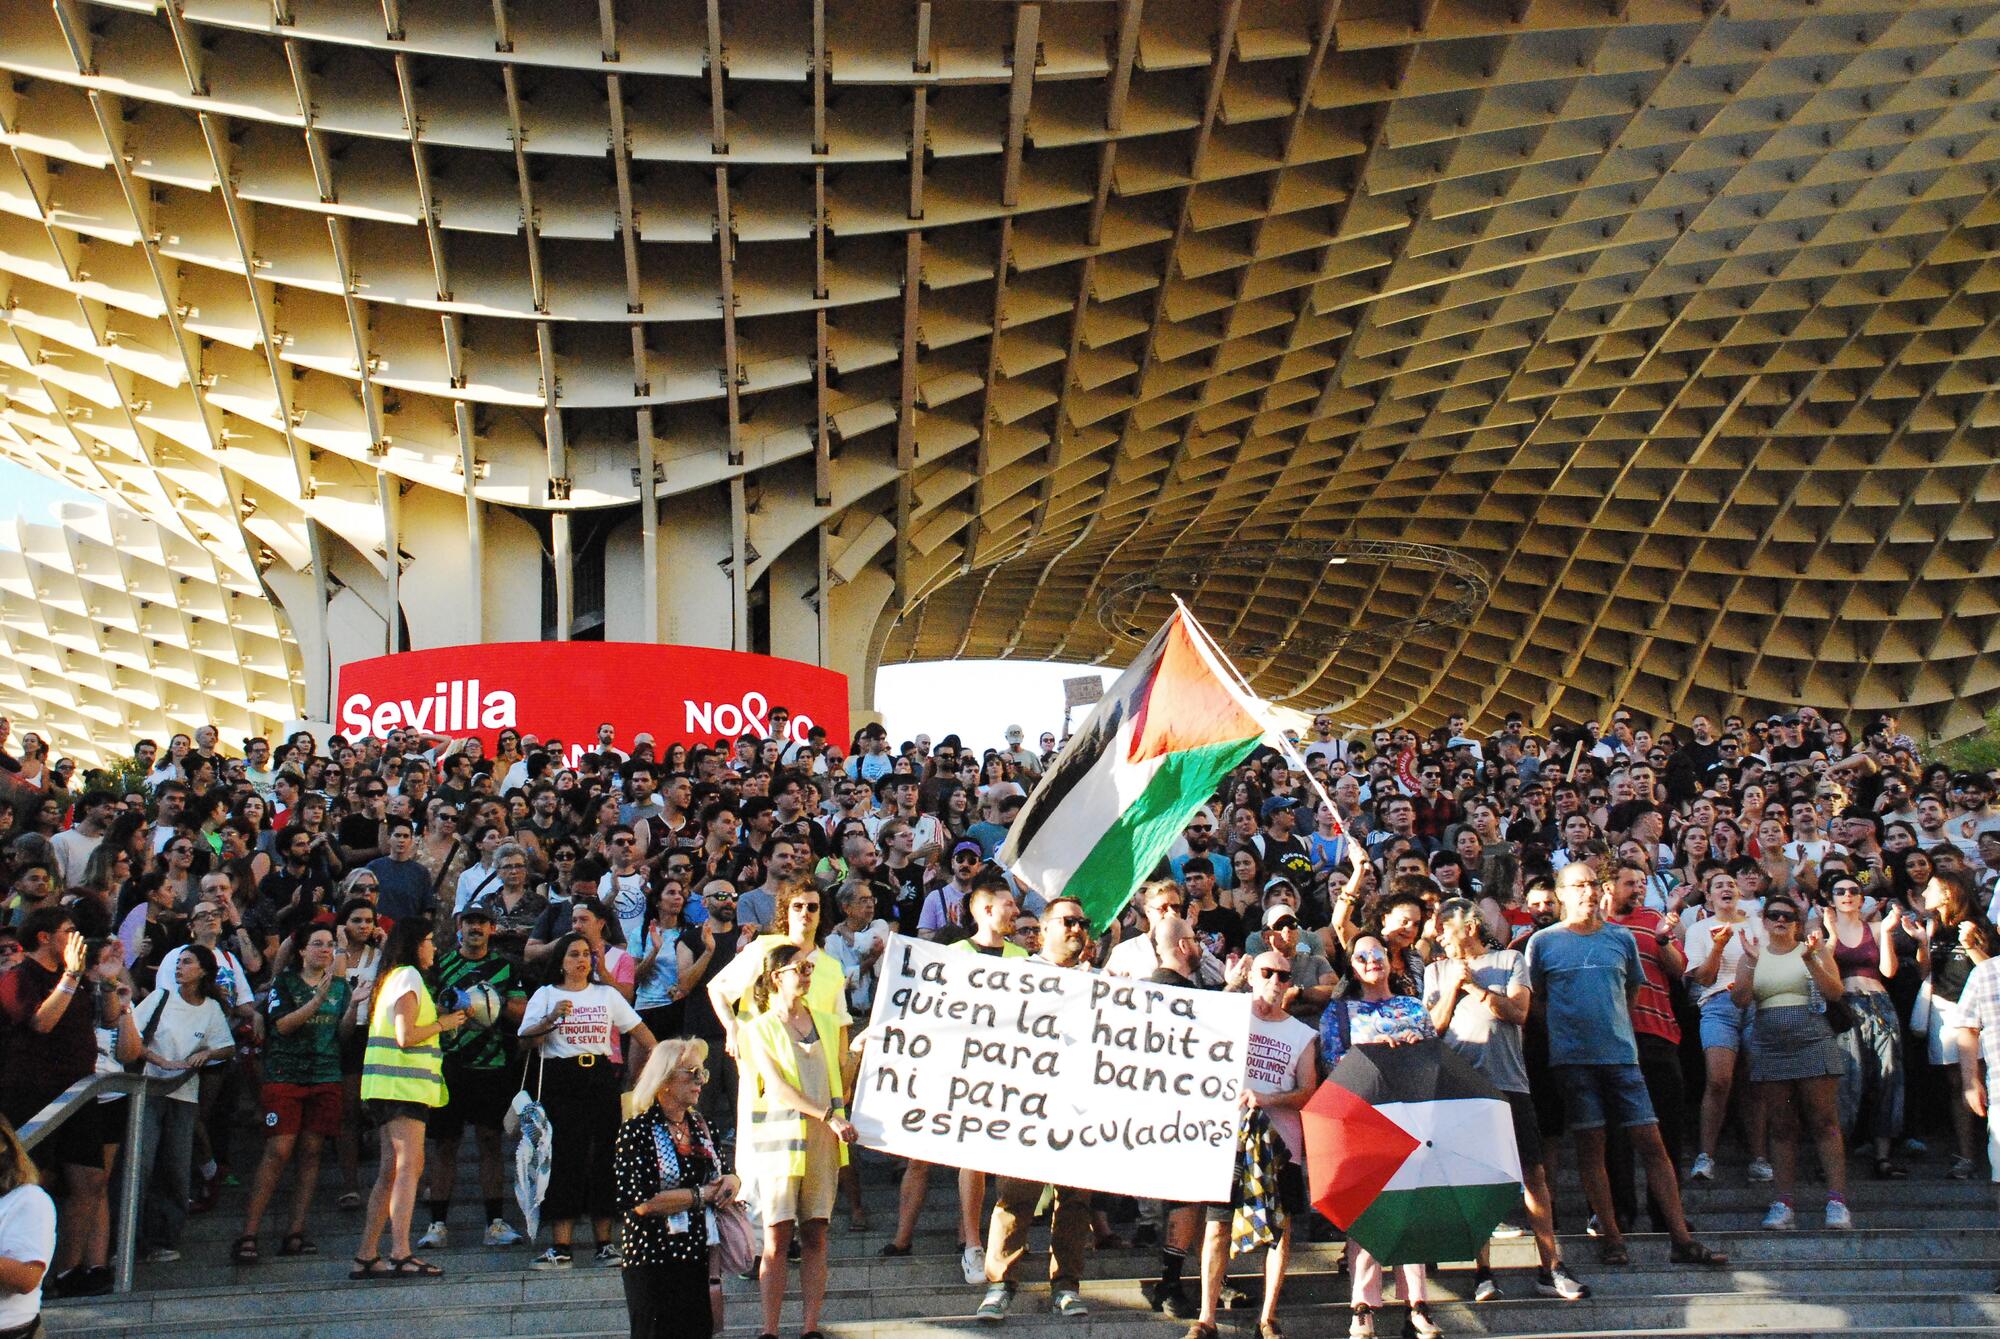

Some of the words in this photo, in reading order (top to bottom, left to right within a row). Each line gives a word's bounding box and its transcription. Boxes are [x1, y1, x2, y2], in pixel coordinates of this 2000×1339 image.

[341, 679, 516, 745] Sevilla
[901, 944, 947, 986] La
[968, 967, 1065, 996] casa
[1091, 979, 1196, 1020] para
[571, 1005, 607, 1015] INDICATO
[892, 987, 996, 1029] quien
[1016, 1000, 1060, 1040] la
[1091, 1007, 1234, 1063] habita
[882, 1024, 932, 1059] no
[960, 1037, 1060, 1078] para
[1093, 1050, 1240, 1102] bancos
[1247, 1056, 1286, 1075] QUILINOS
[1248, 1069, 1282, 1085] SEVILLA
[876, 1066, 918, 1100] ni
[947, 1075, 1048, 1121] para
[900, 1107, 1234, 1152] especuculadores
